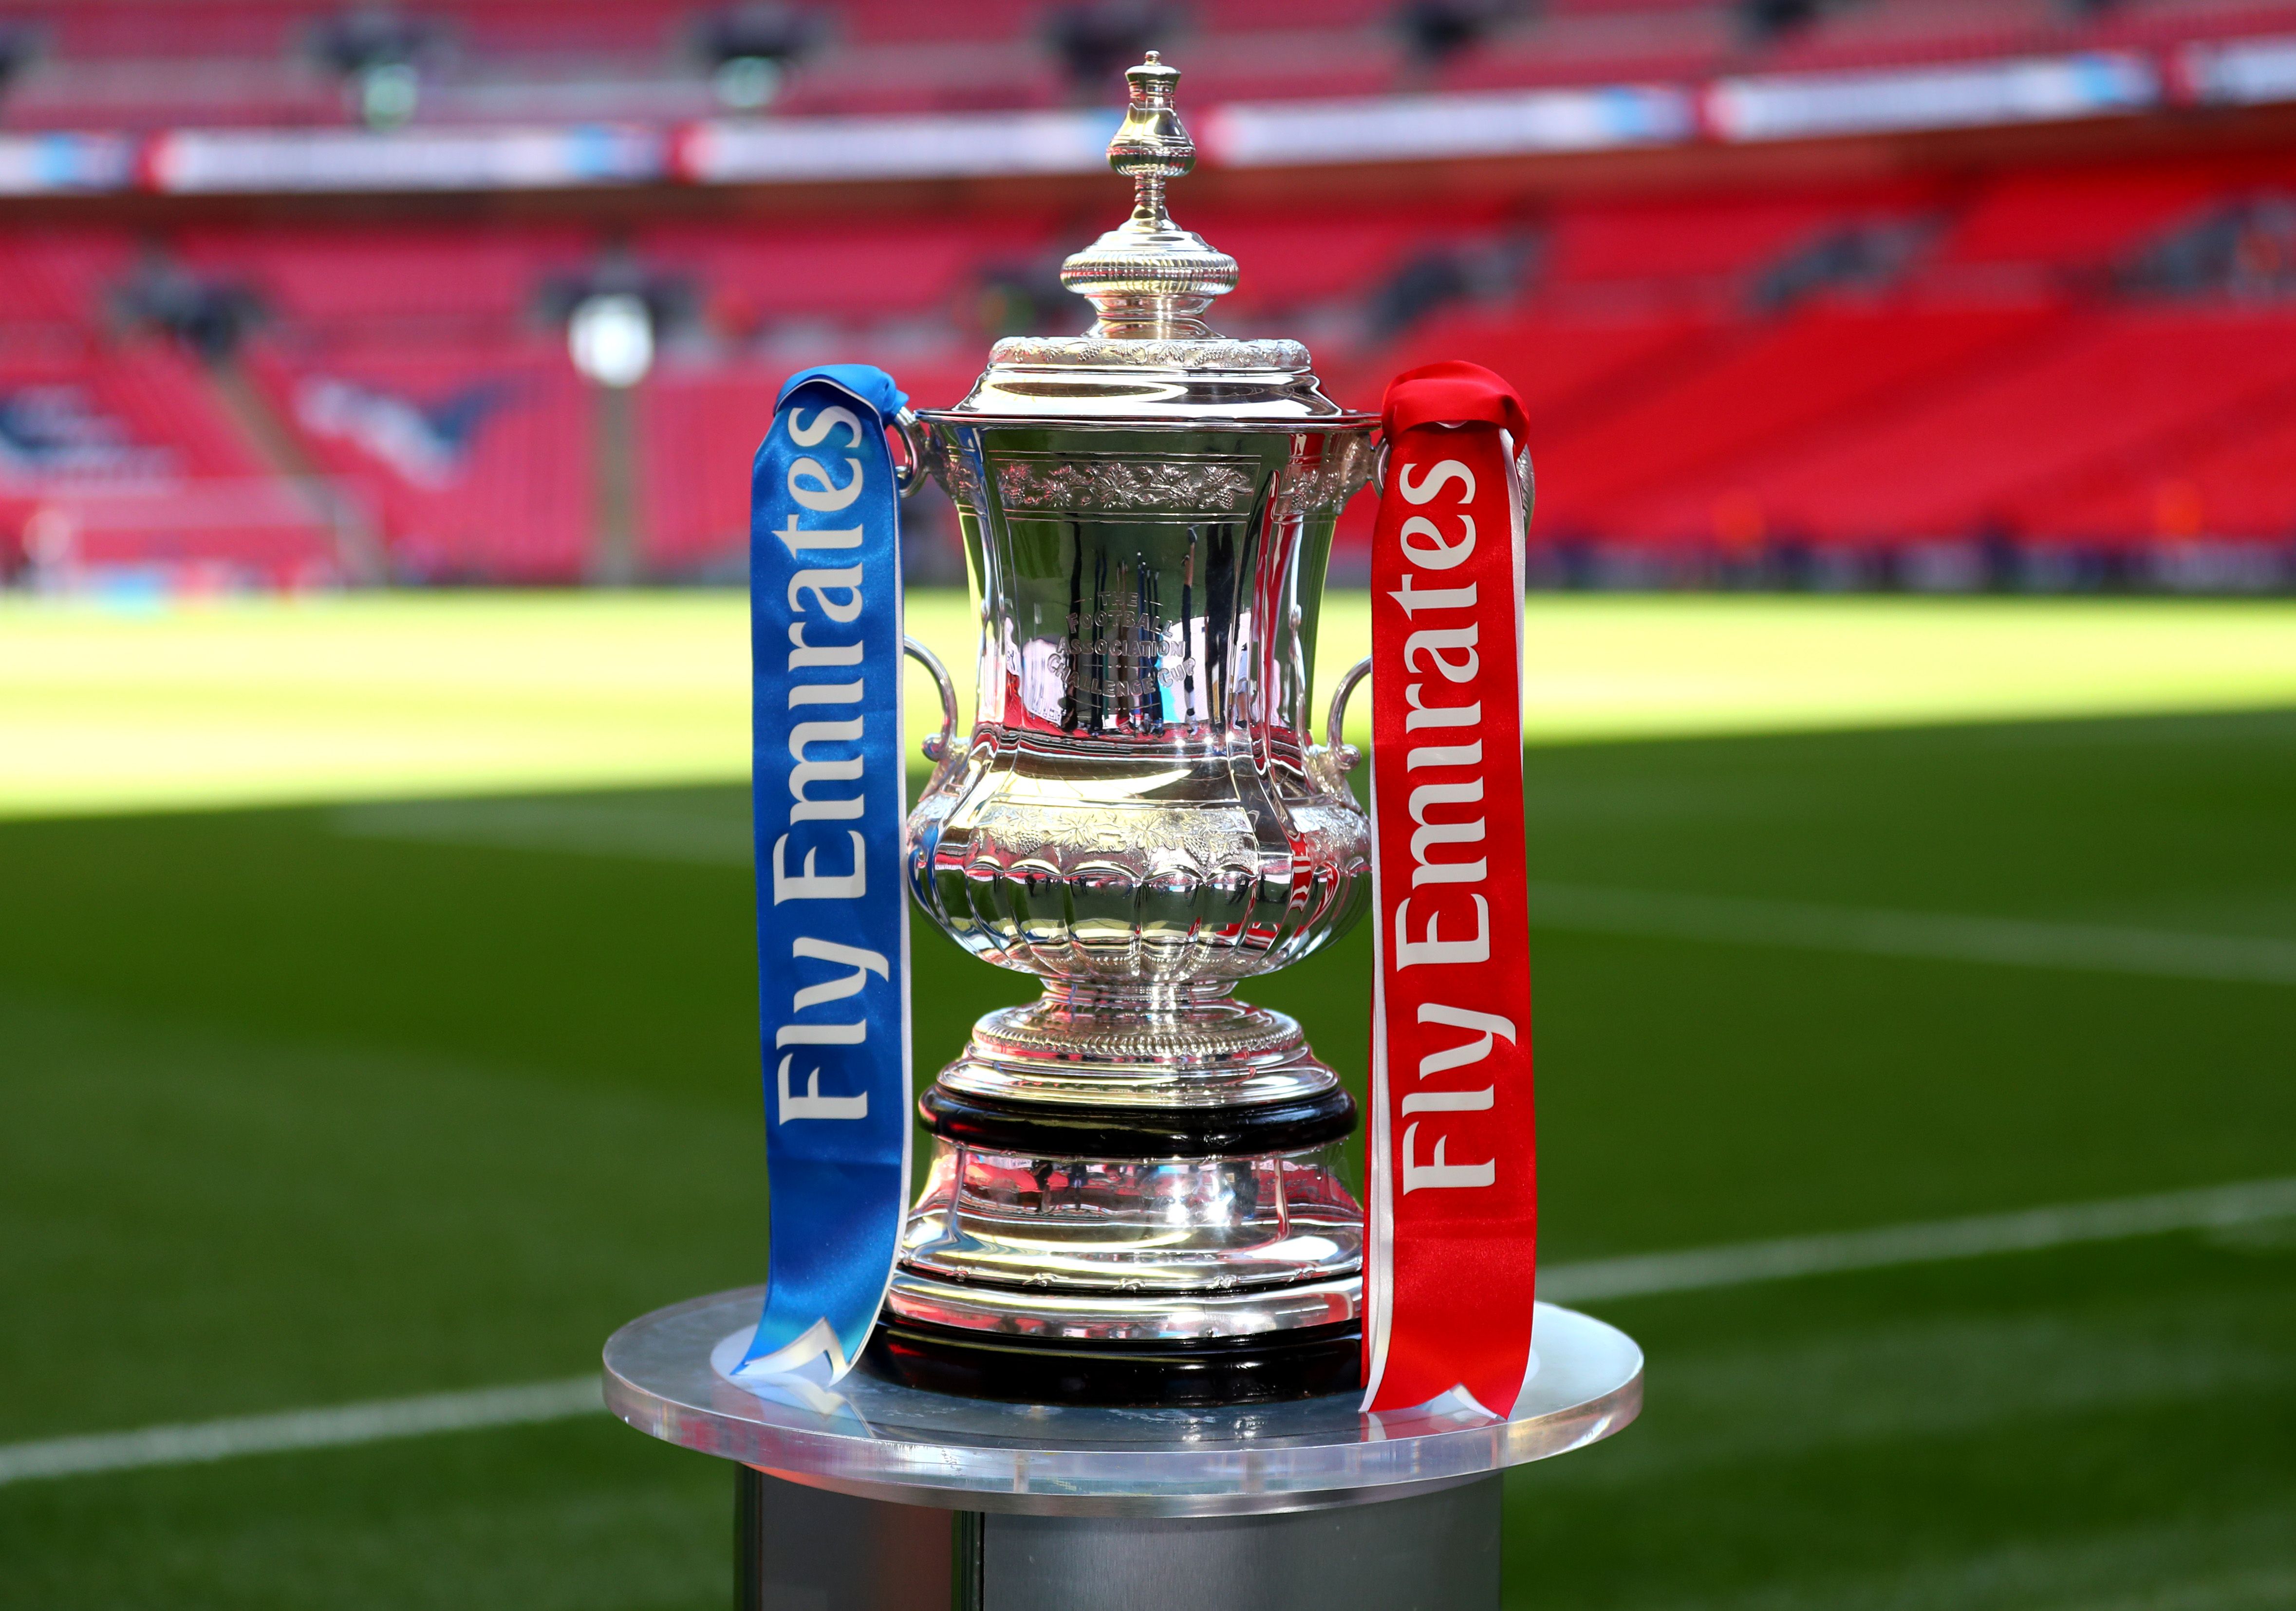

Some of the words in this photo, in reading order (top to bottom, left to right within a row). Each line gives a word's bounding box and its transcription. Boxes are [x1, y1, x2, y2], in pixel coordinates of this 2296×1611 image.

[772, 406, 865, 906] Emirates
[1057, 637, 1185, 658] ASSOCIATION
[1066, 611, 1173, 637] FOOTBALL
[1098, 592, 1138, 607] THE
[1047, 654, 1156, 697] CHALLENGE
[1158, 658, 1195, 687] CUP
[1387, 459, 1490, 972] Emirates
[776, 937, 889, 1126] Fly
[1402, 1002, 1516, 1196] Fly
